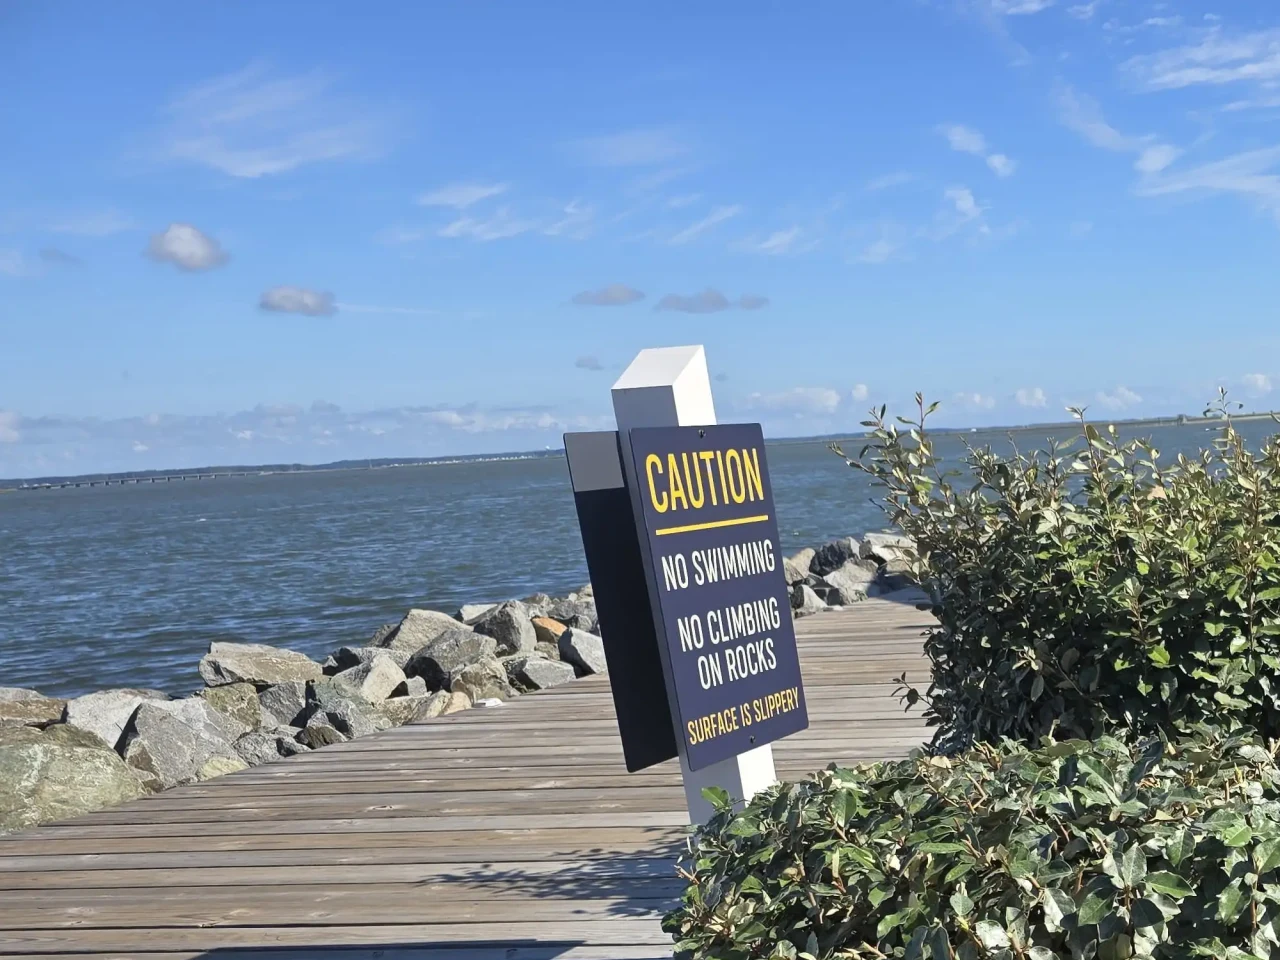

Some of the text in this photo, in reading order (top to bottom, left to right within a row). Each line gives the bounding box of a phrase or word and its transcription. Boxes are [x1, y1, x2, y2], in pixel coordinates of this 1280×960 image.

[645, 448, 764, 513] CAUTION
[661, 539, 775, 592] NO SWIMMING
[677, 597, 781, 652] NO CLIMBING
[698, 638, 777, 690] ON ROCKS
[687, 687, 800, 745] SURFACE IS SLIPPERY
